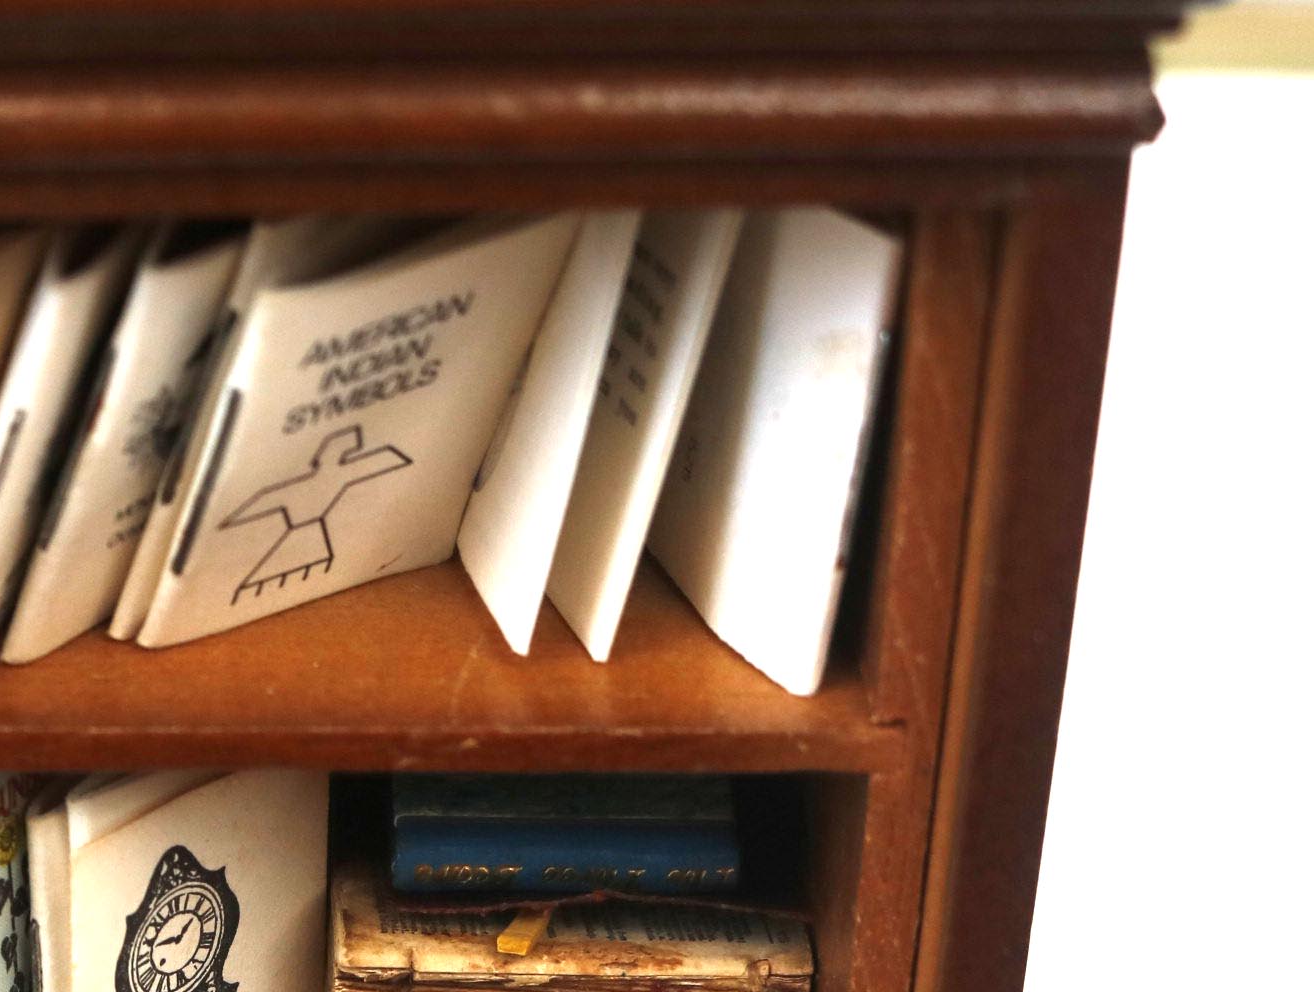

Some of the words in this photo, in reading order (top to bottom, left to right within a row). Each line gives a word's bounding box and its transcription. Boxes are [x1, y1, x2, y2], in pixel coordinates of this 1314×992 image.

[299, 291, 476, 370] AMERICAN
[320, 334, 432, 392] INDIAN
[283, 358, 441, 434] SYMBOLS
